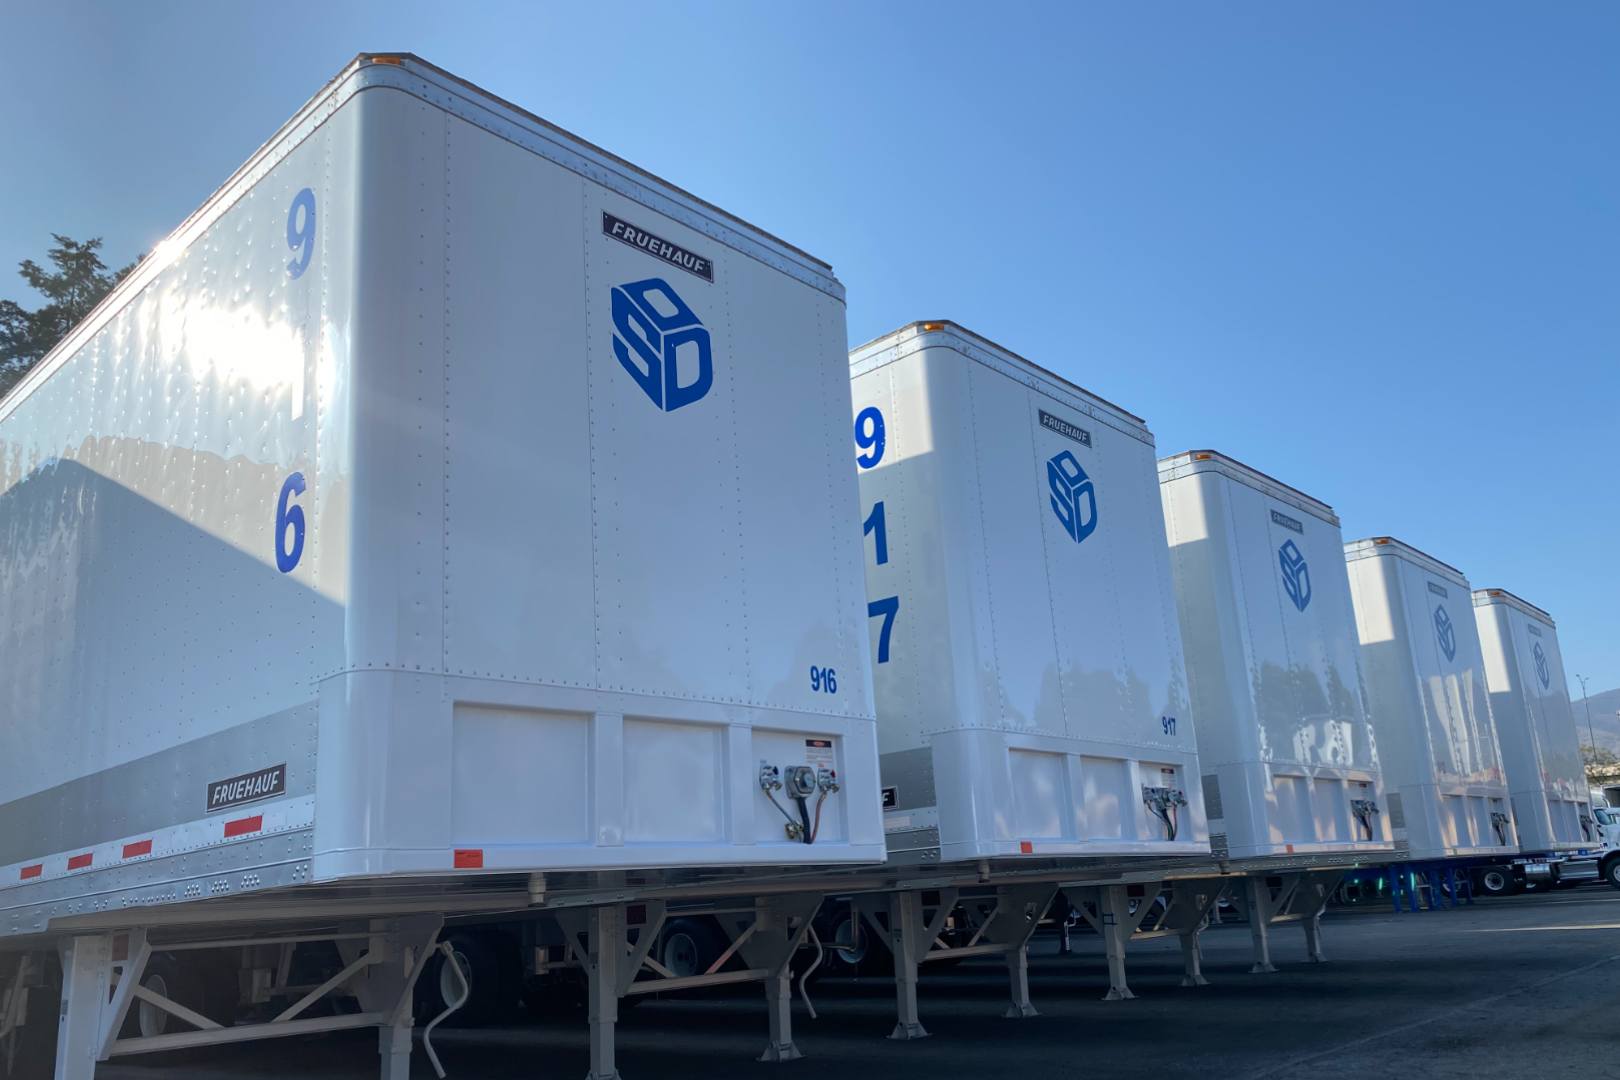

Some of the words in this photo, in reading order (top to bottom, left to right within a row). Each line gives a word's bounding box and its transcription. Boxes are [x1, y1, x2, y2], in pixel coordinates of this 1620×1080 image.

[611, 221, 706, 274] FRUEHAUF
[1043, 414, 1088, 442] FRUEHAUF
[810, 664, 838, 694] 916
[1161, 715, 1176, 736] 917
[211, 770, 280, 806] FRUEHAUF
